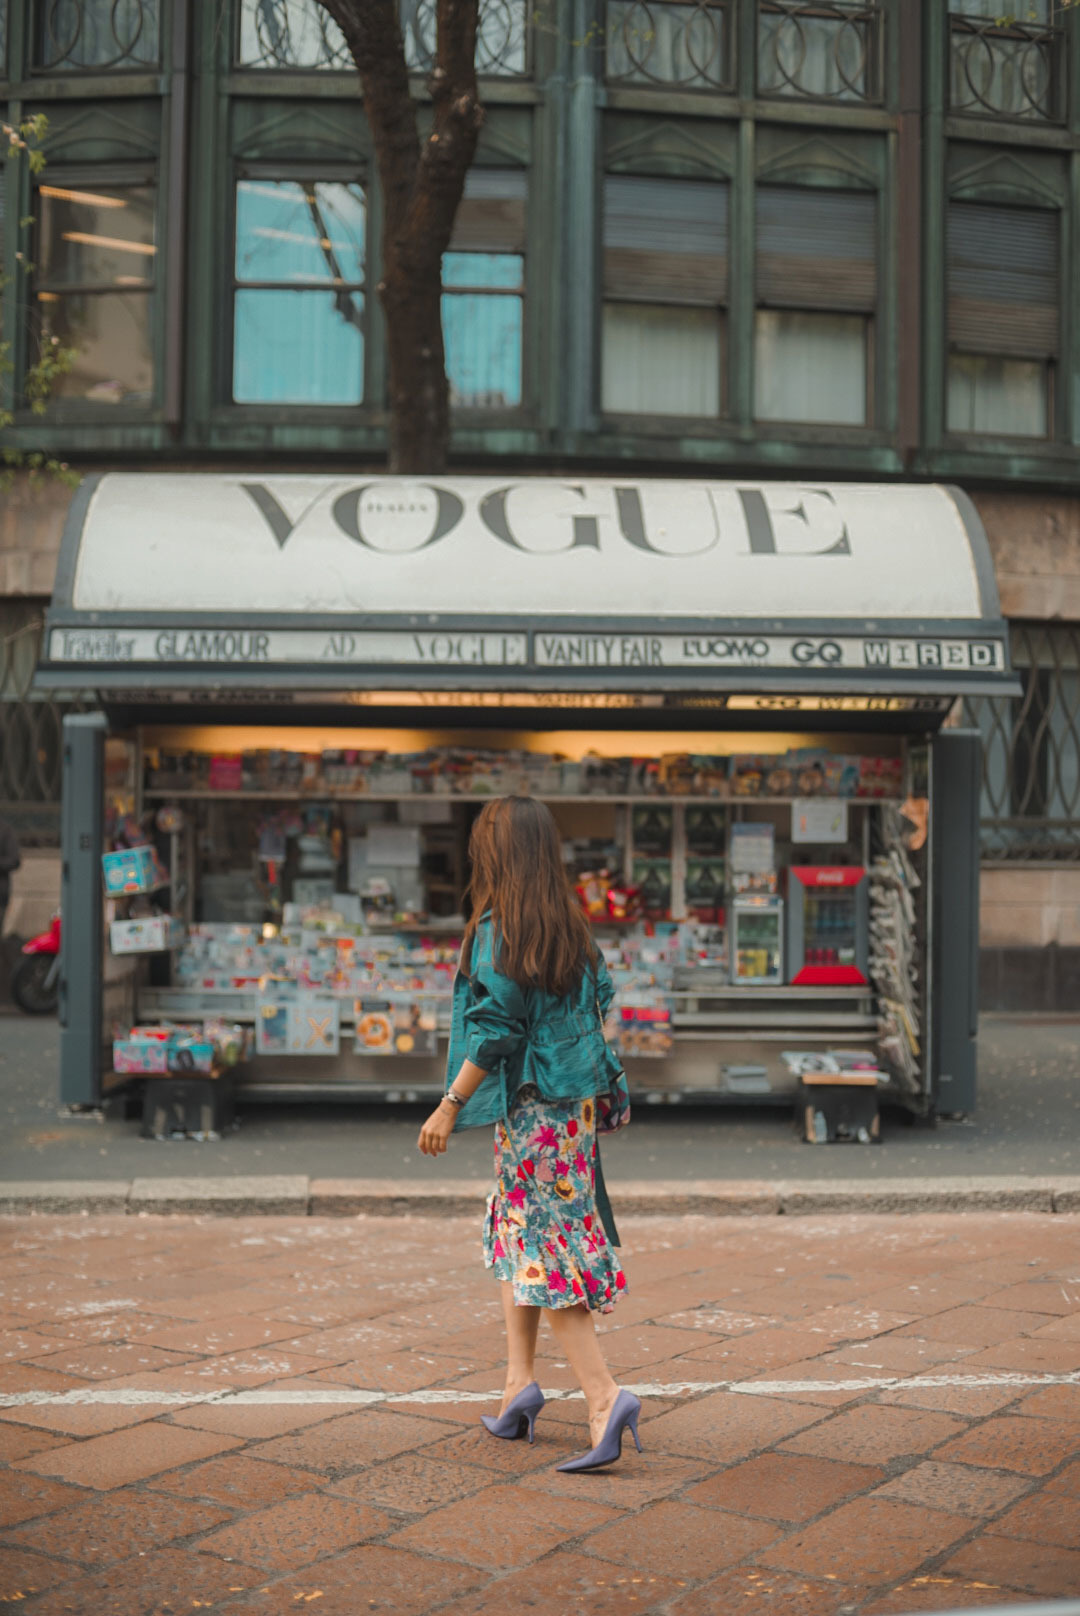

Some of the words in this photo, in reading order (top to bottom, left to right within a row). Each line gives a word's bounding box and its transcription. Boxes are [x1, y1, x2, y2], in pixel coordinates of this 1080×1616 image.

[238, 482, 852, 556] VOGUE
[155, 632, 269, 661] GLAMOUR
[322, 634, 356, 659] AD
[412, 634, 526, 665] VOGUE
[541, 637, 614, 666] VANITY
[619, 638, 664, 667] FAIR
[683, 639, 770, 659] L'UOMO
[791, 641, 844, 665] GQ
[865, 641, 997, 668] WIRED
